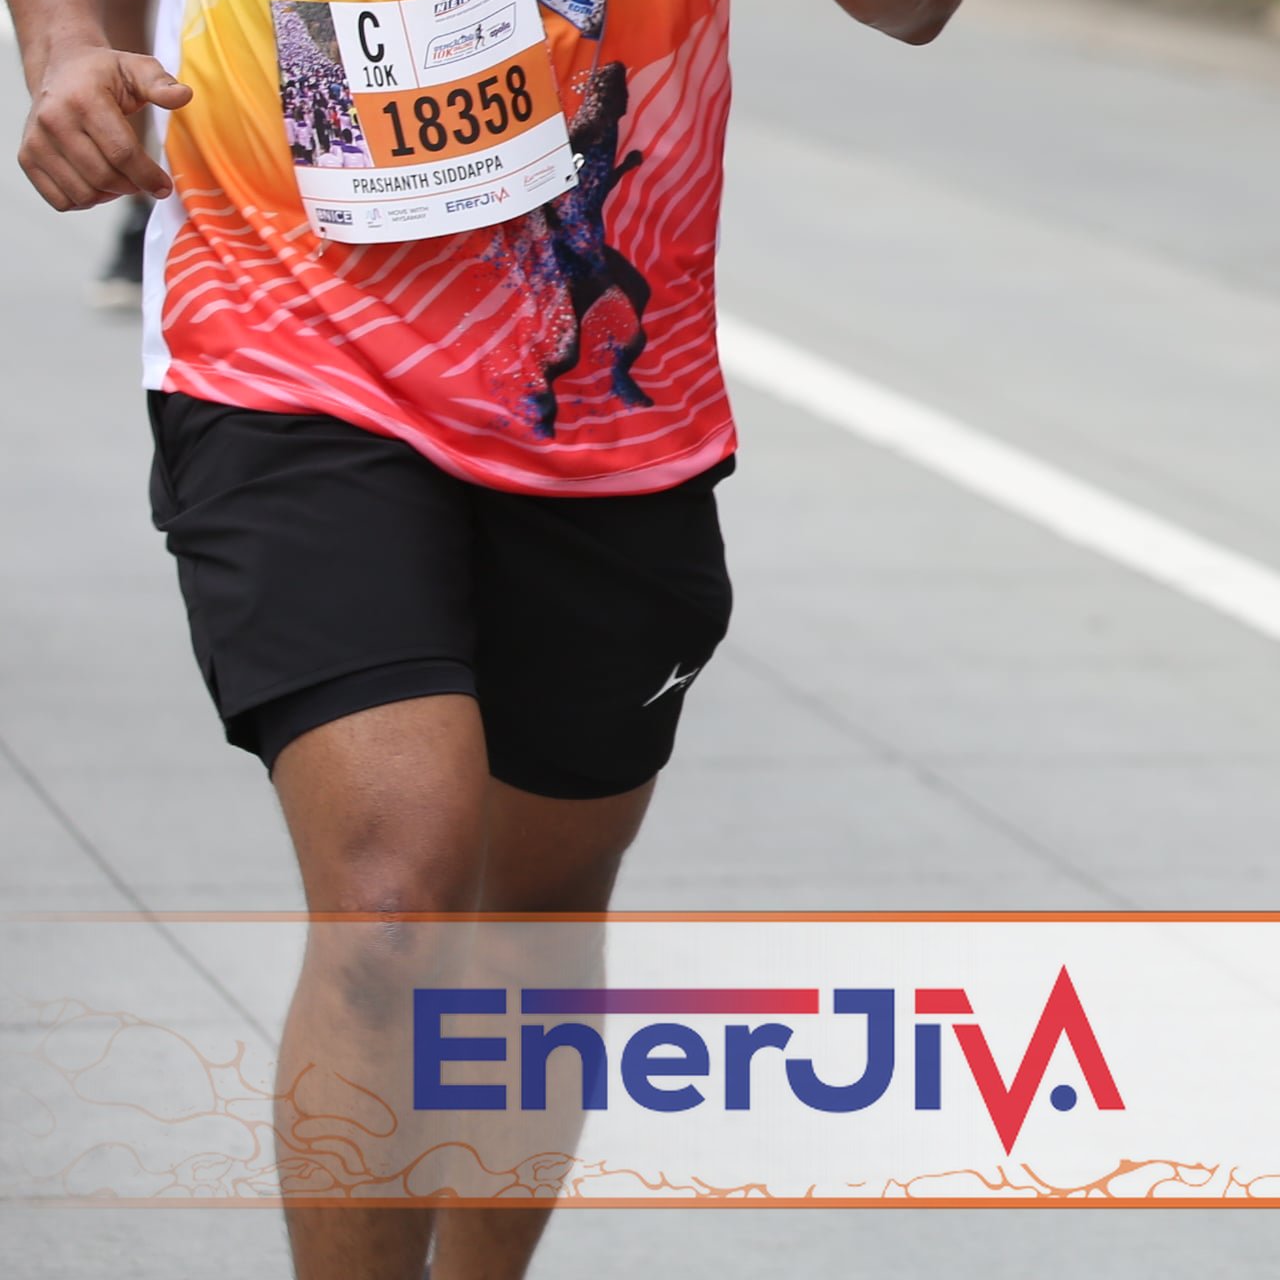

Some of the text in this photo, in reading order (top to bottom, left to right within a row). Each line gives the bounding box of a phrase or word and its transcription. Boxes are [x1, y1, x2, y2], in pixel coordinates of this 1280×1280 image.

[358, 10, 385, 63] C
[363, 65, 398, 88] 10K
[382, 65, 533, 157] 18358
[353, 173, 429, 193] PRASHANTH
[434, 155, 504, 186] SIDDAPPA
